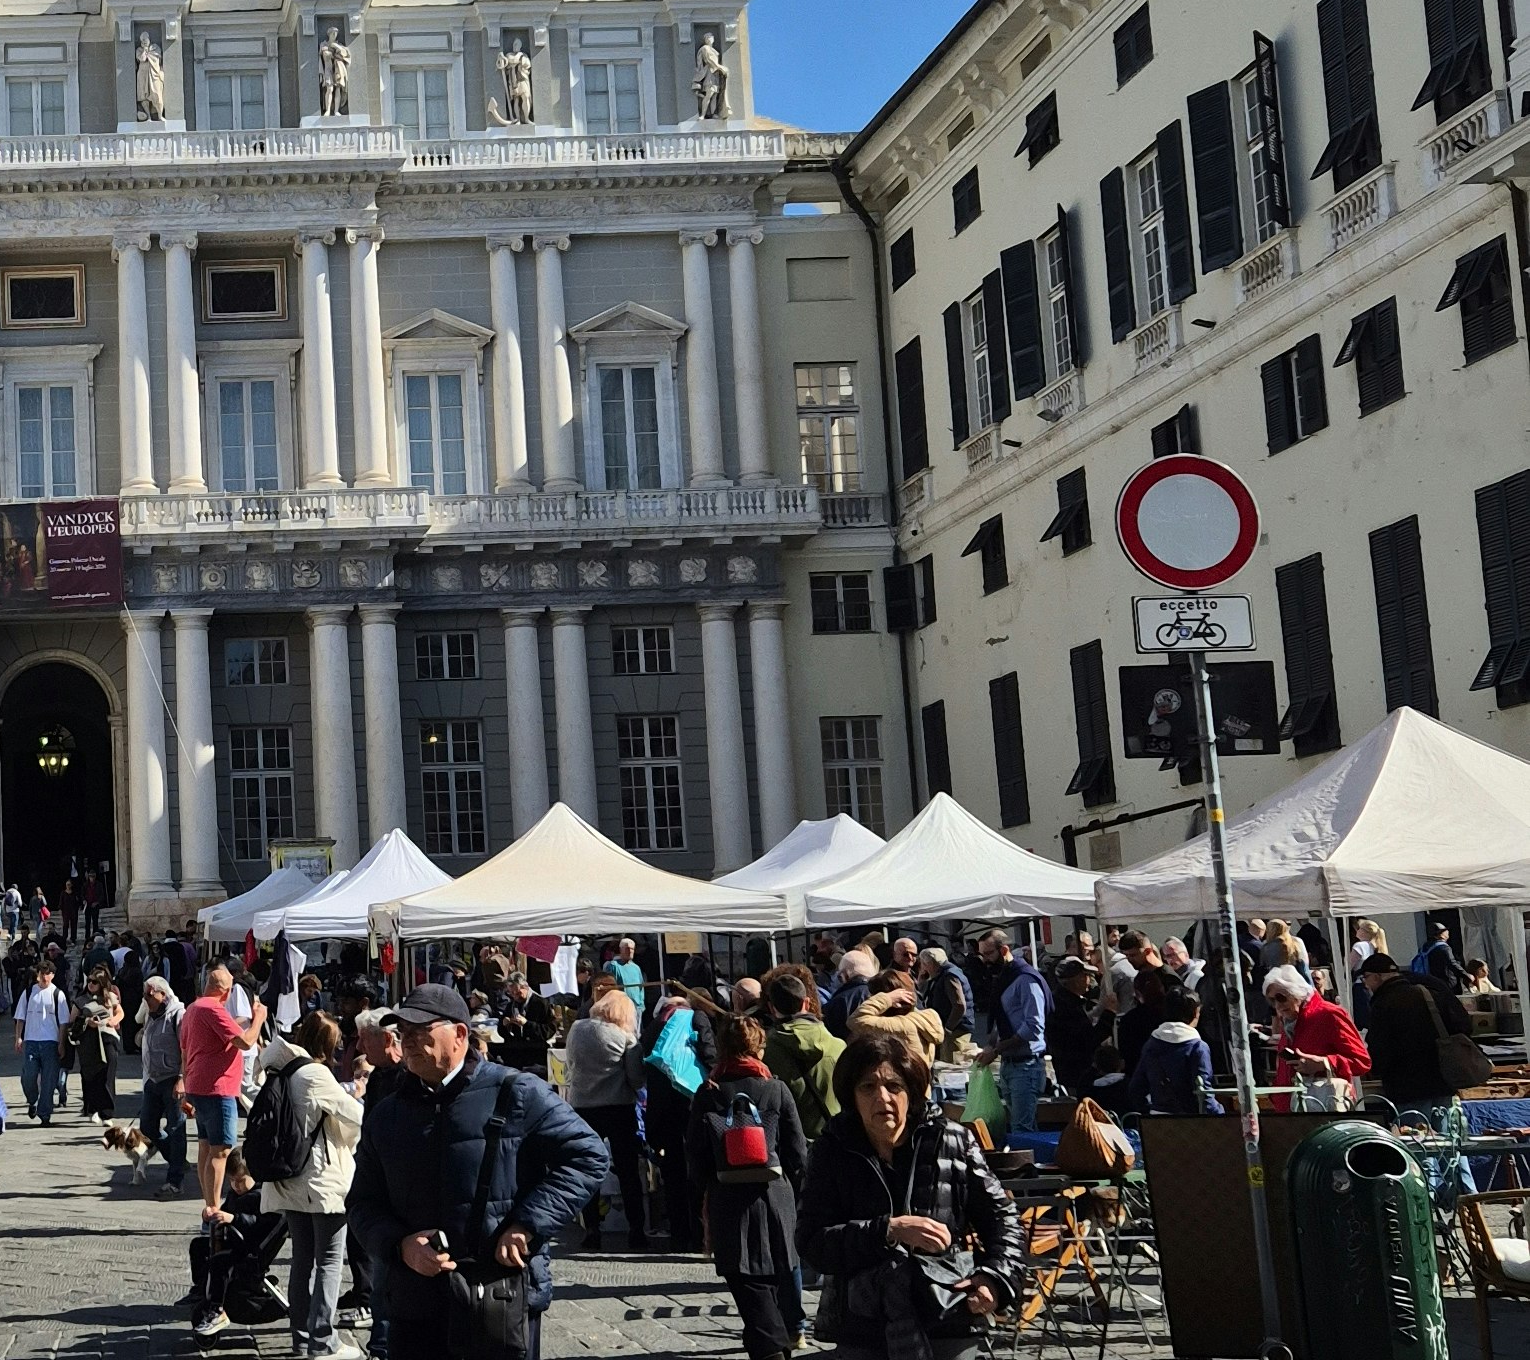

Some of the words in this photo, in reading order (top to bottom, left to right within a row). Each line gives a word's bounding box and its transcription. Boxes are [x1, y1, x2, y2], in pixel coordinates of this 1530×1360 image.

[47, 514, 75, 526] VAN
[77, 511, 114, 525] DYCK
[48, 523, 115, 537] L'EUROPEO
[1159, 599, 1218, 611] eccetto
[1390, 1274, 1418, 1342] AMIU
